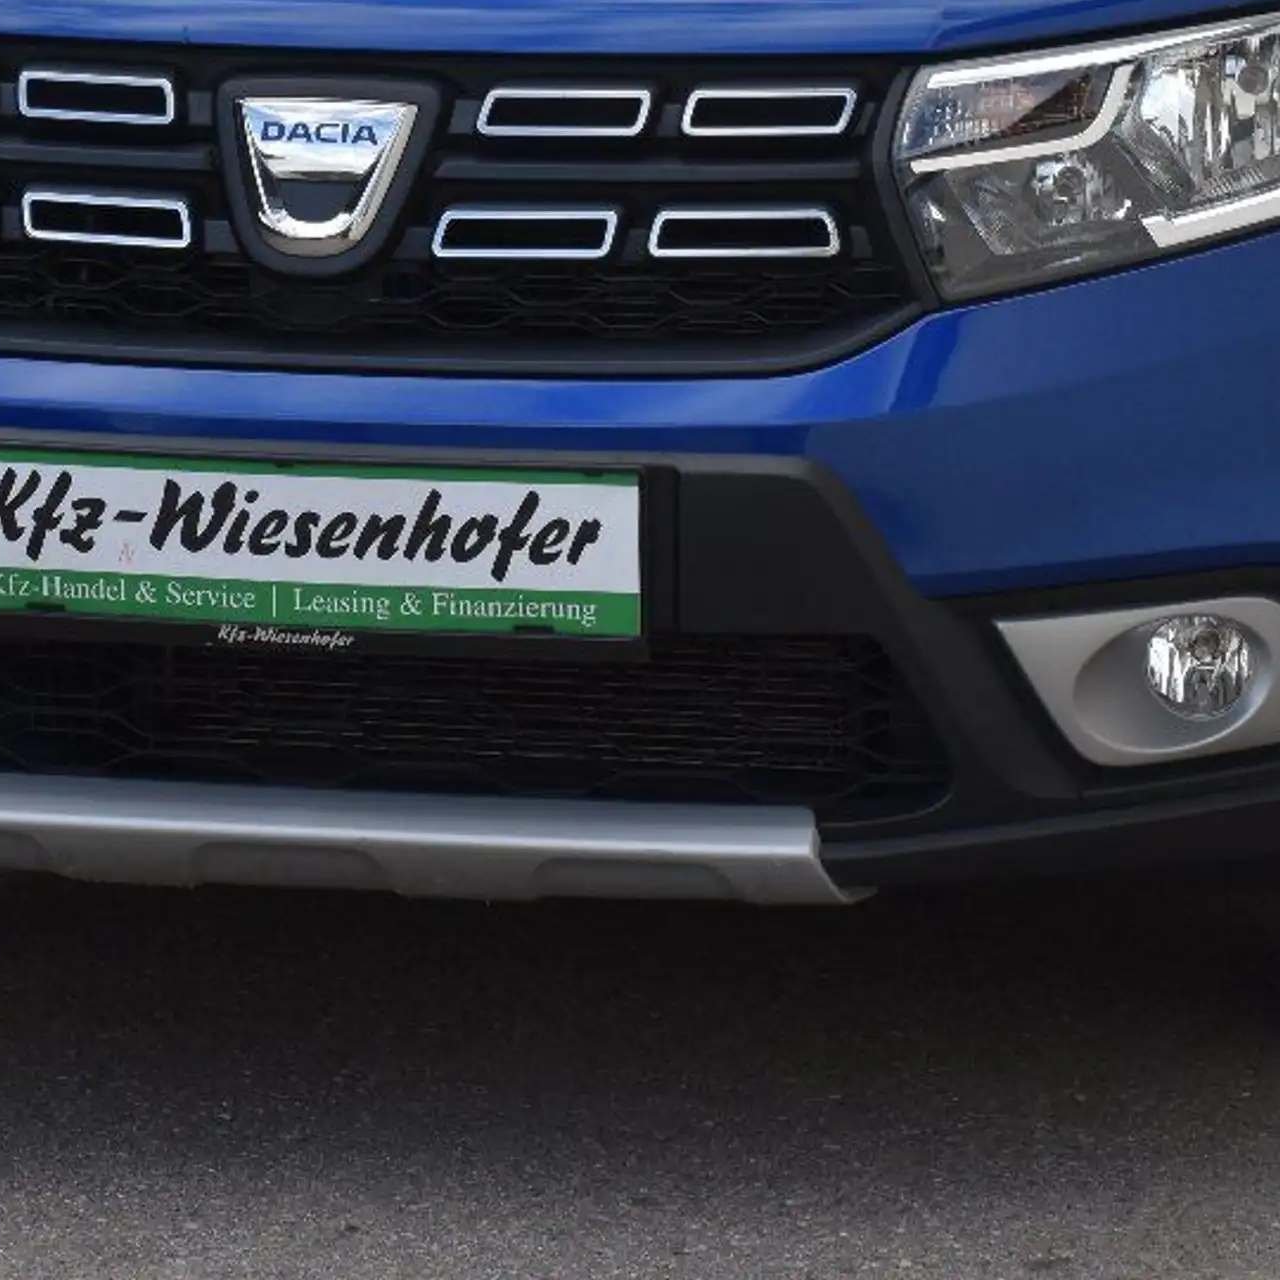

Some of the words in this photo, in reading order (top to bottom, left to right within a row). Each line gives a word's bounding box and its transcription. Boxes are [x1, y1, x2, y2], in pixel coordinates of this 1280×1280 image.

[260, 120, 379, 146] DACIA
[134, 580, 158, 604] &
[166, 581, 258, 610] Service
[293, 587, 391, 621] Leasing
[400, 592, 424, 617] &
[431, 593, 598, 628] Finanzierung
[217, 622, 356, 649] Kfz-Wiesenhofer
